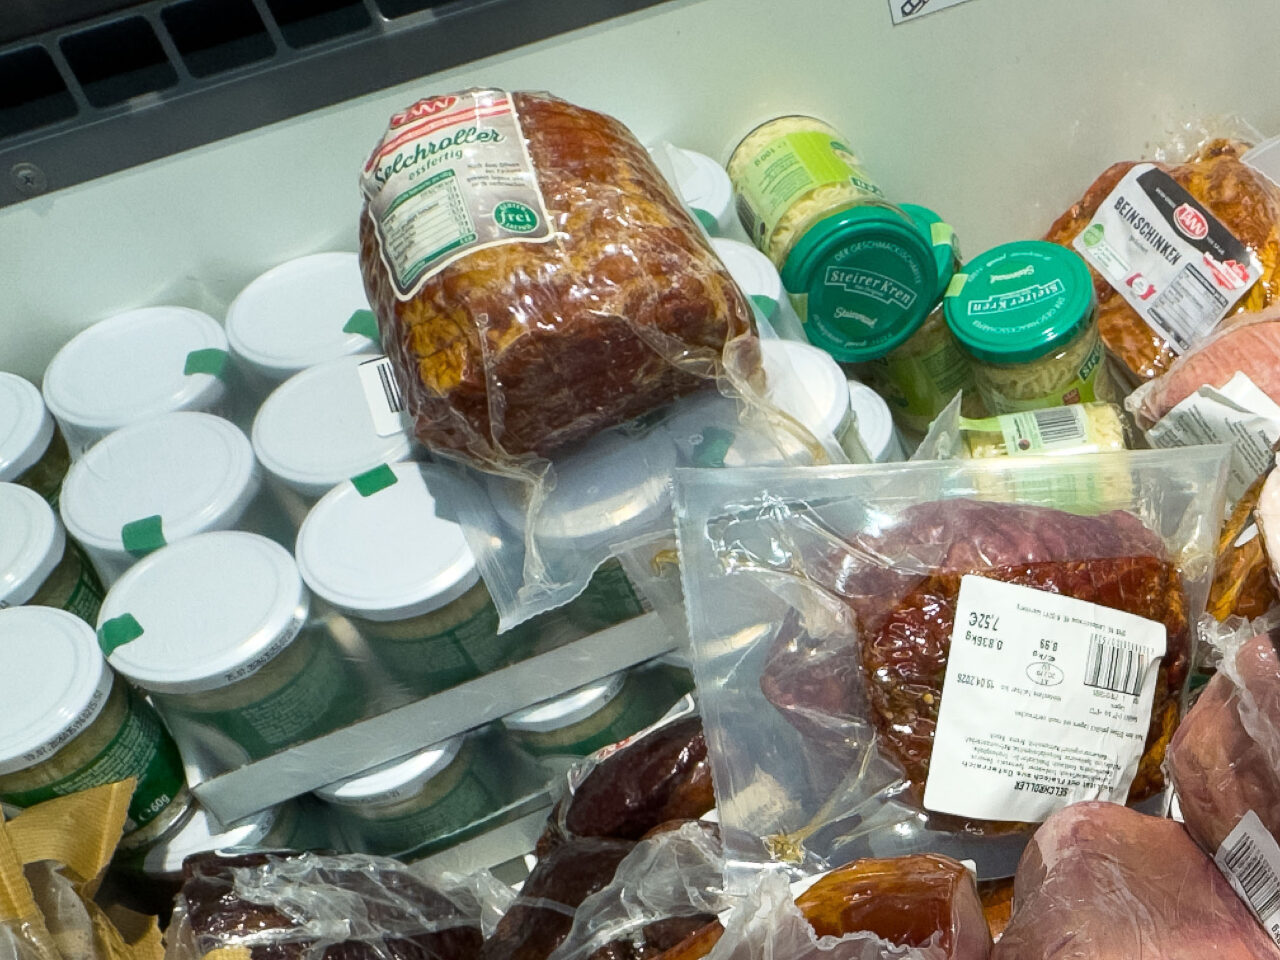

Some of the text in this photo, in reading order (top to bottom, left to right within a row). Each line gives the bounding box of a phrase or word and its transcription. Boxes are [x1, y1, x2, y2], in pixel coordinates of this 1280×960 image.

[375, 127, 505, 188] Selchroller
[500, 210, 530, 223] frei
[1114, 196, 1182, 266] BEINSCHINKEN
[1013, 780, 1068, 796] SELCHROLLER
[151, 793, 171, 812] 60g
